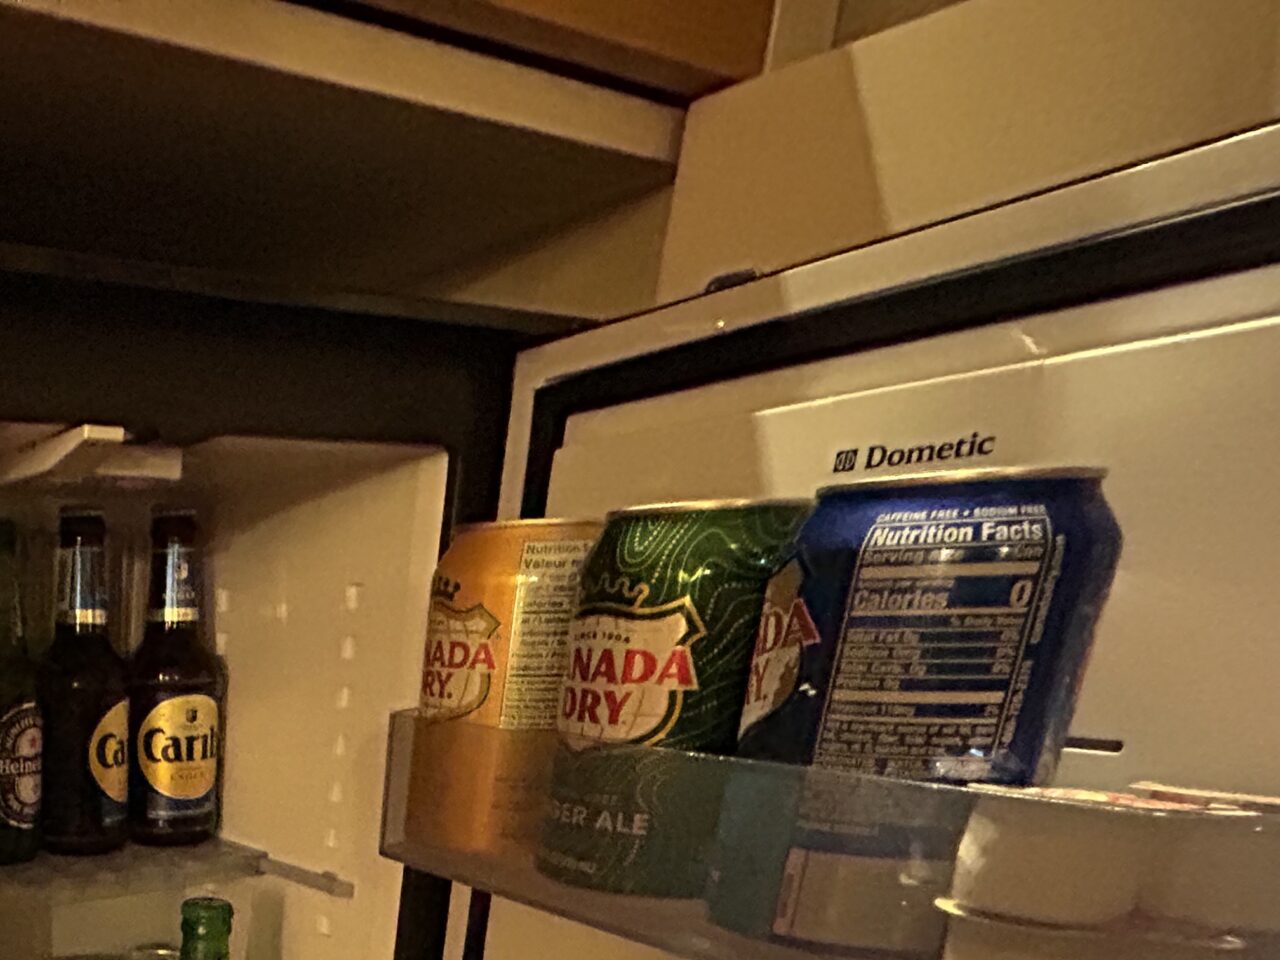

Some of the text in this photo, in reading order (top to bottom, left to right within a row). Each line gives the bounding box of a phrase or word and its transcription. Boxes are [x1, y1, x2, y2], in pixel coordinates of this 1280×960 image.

[864, 431, 997, 470] Dometic
[877, 510, 928, 522] CAFFEINE
[930, 508, 959, 520] FREE
[870, 520, 1044, 546] Nutrition Facts
[524, 558, 567, 570] Valeur
[853, 578, 1033, 610] Calories 0
[572, 645, 694, 686] NADA
[595, 811, 650, 836] ALE
